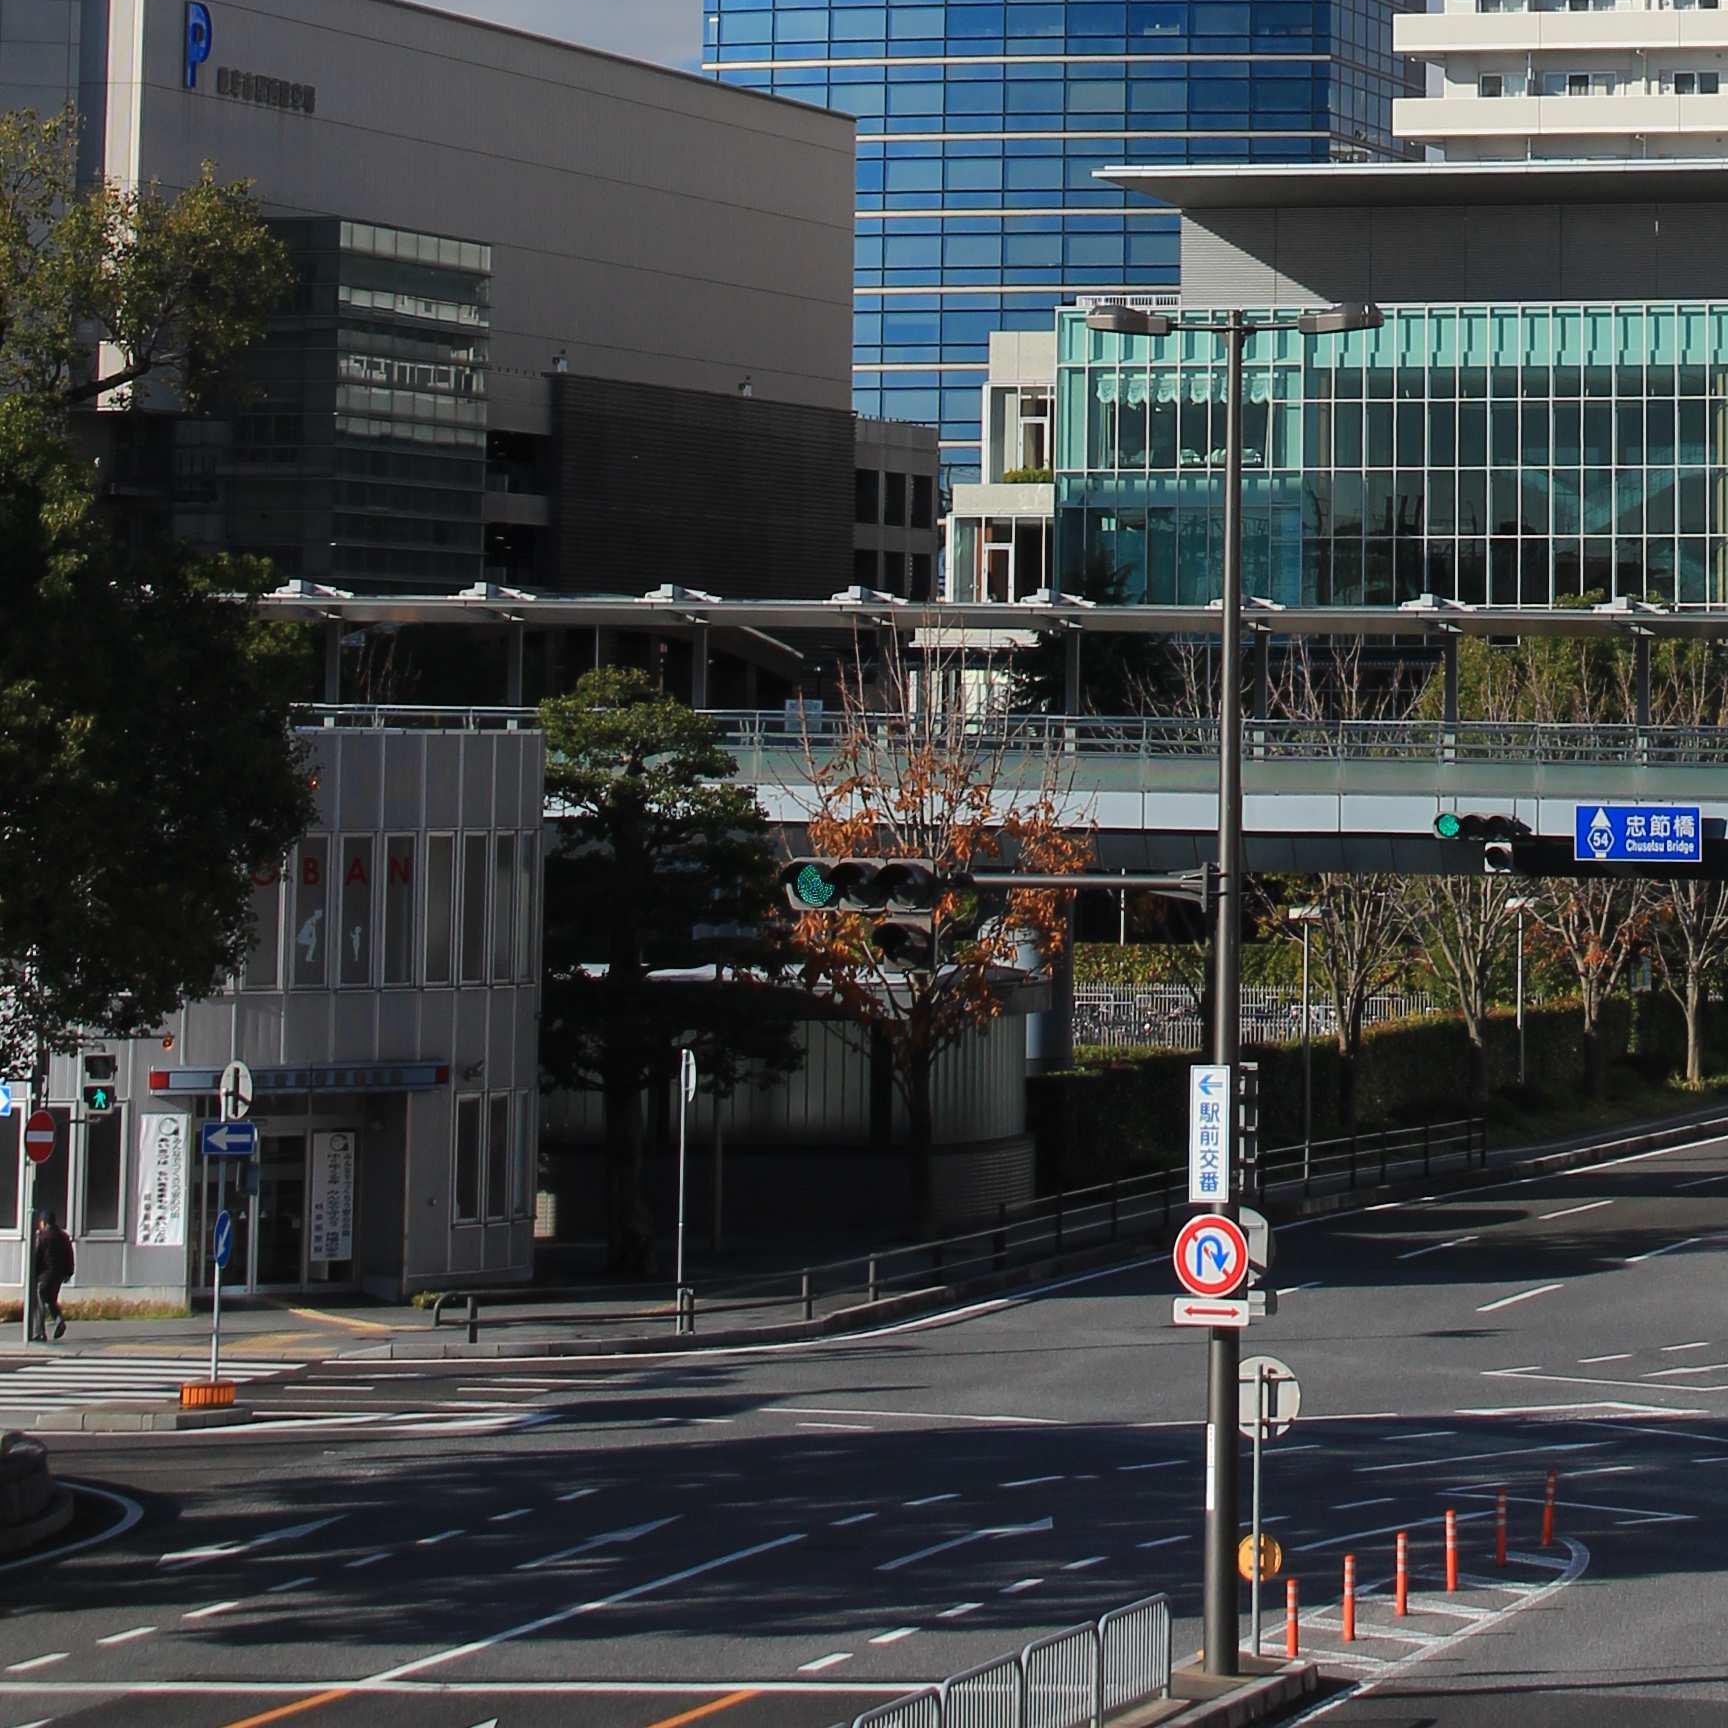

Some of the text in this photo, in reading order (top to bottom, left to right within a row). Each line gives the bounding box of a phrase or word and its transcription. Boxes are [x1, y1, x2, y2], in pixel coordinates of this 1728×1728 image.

[1625, 814, 1695, 838] 忠節橋
[1592, 832, 1609, 847] 54
[1625, 838, 1695, 854] Chusetsu Bridge
[1199, 1101, 1221, 1193] 駅前交番
